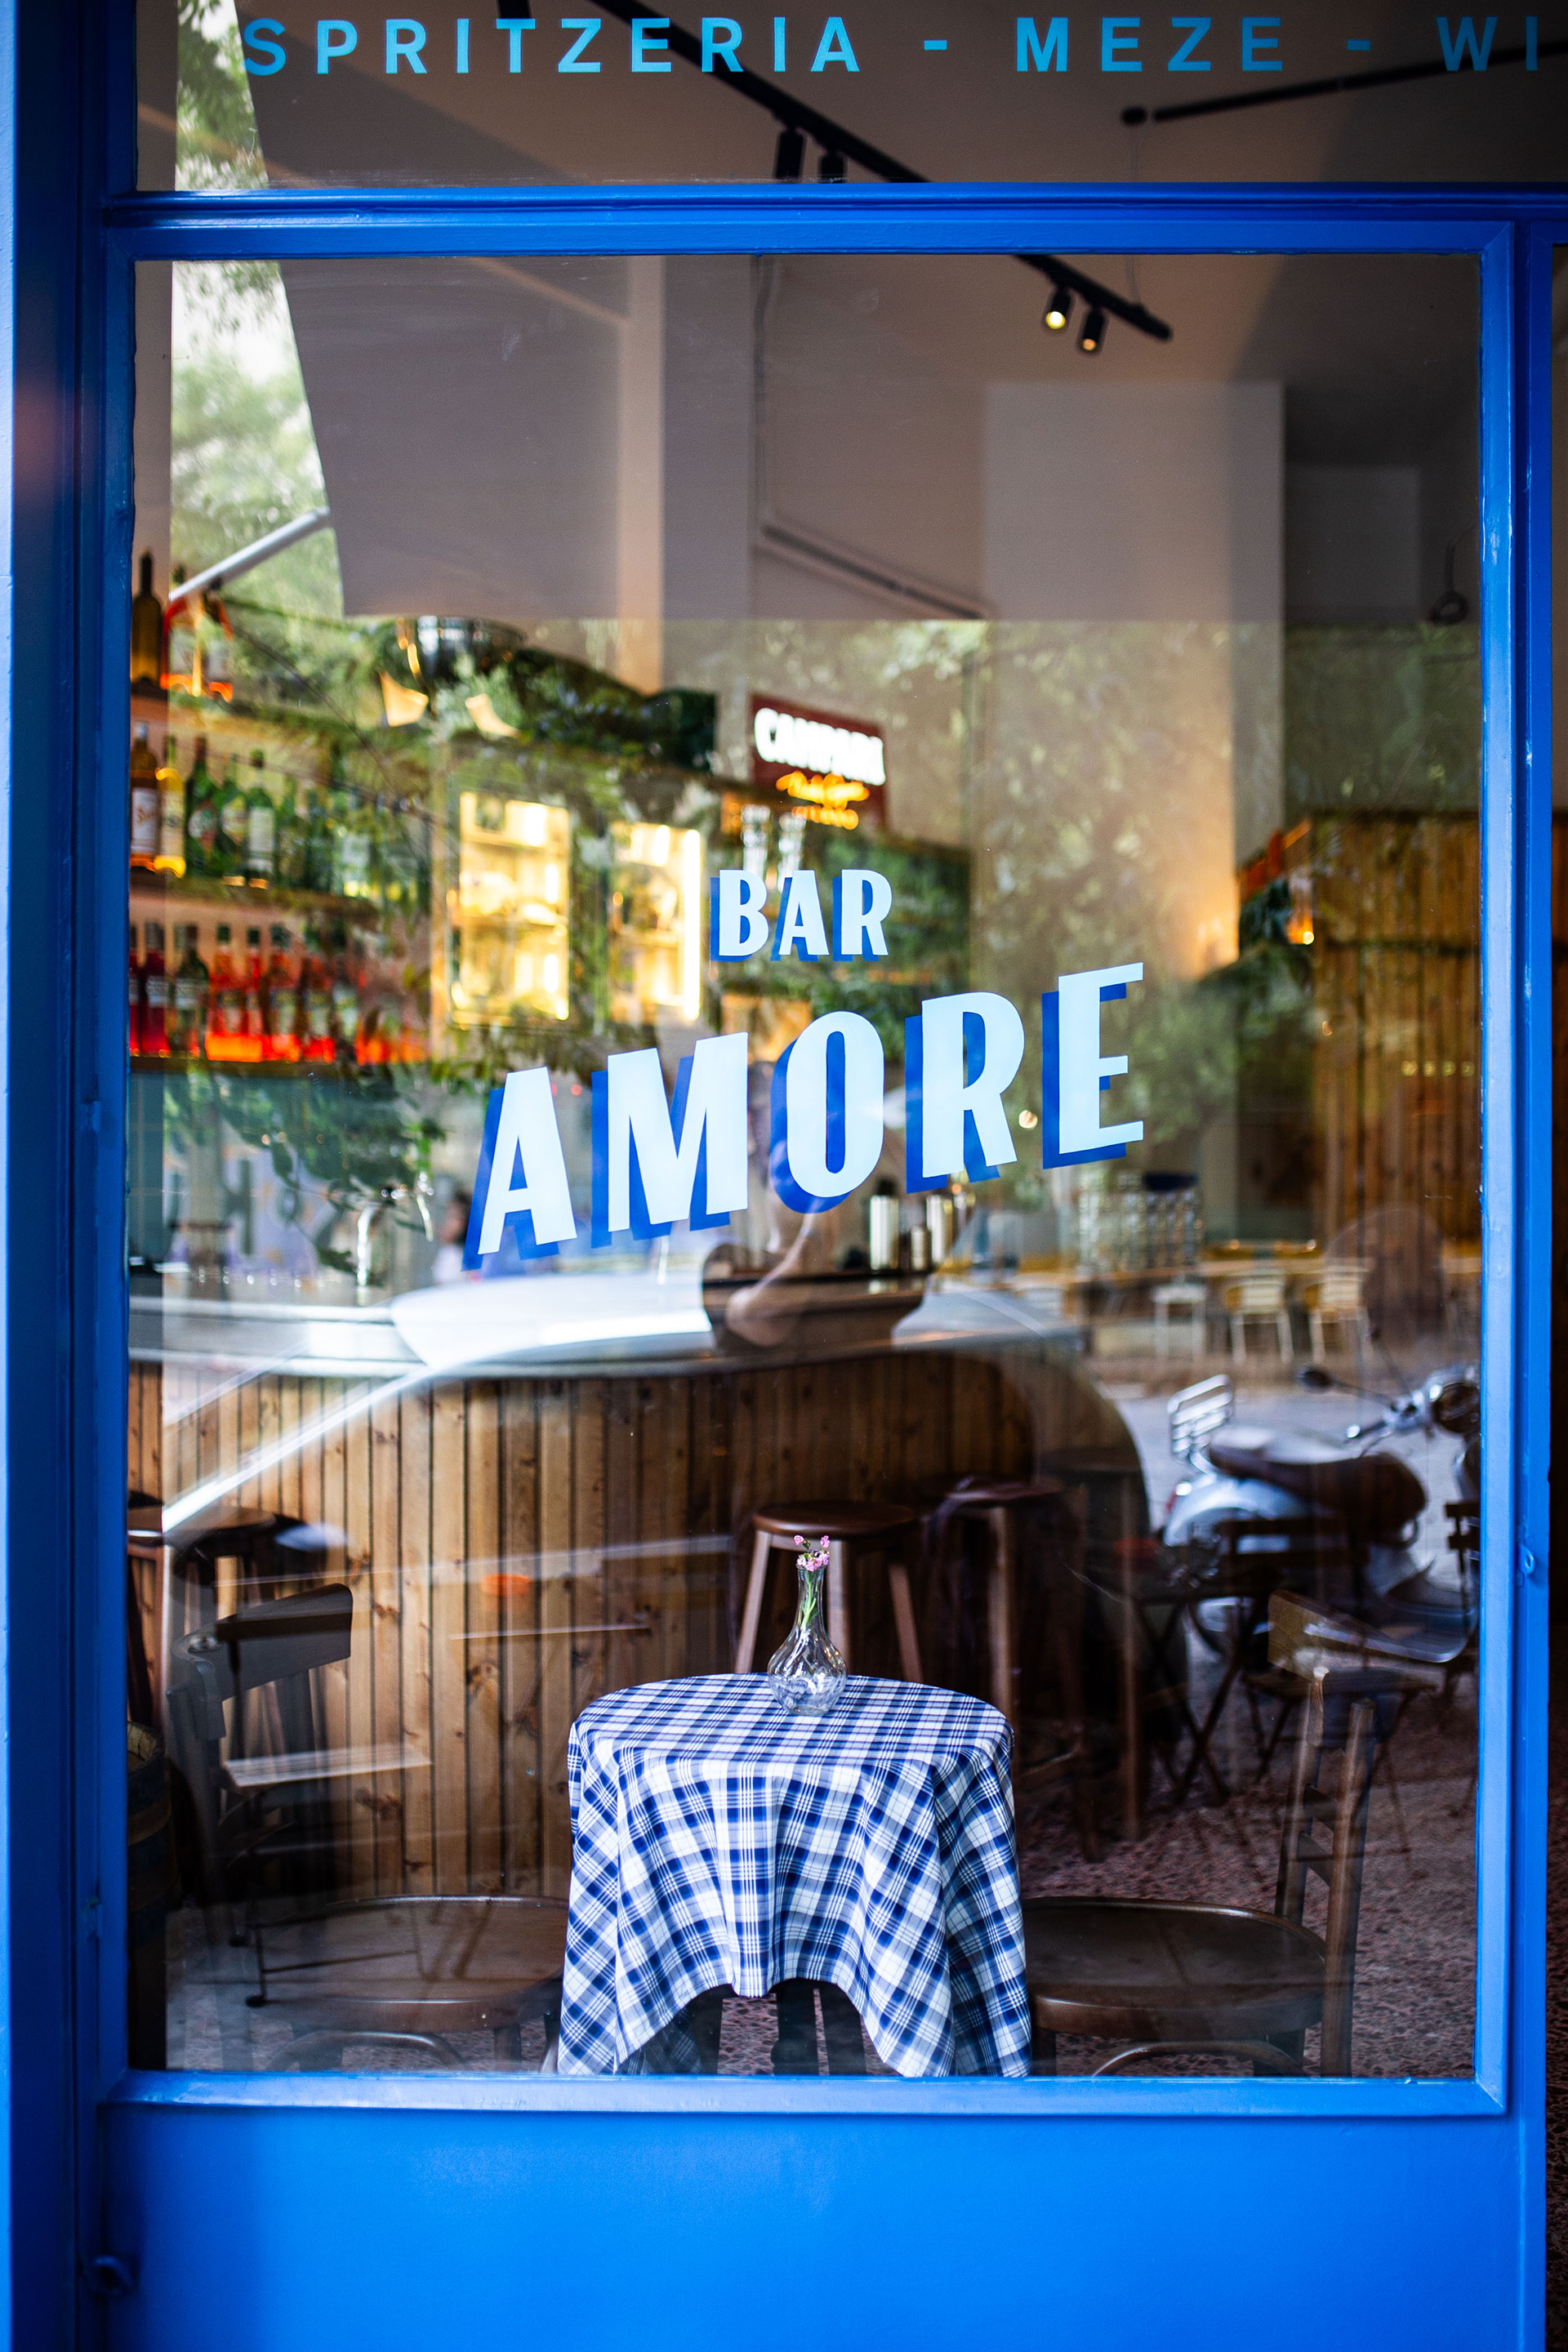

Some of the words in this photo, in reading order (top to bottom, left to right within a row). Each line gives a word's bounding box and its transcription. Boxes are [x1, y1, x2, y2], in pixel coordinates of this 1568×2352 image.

[243, 16, 860, 76] SPRITZERIA
[1017, 16, 1284, 72] MEZE
[1436, 16, 1539, 72] WI
[710, 869, 893, 962] BAR
[461, 962, 1144, 1272] AMORE
